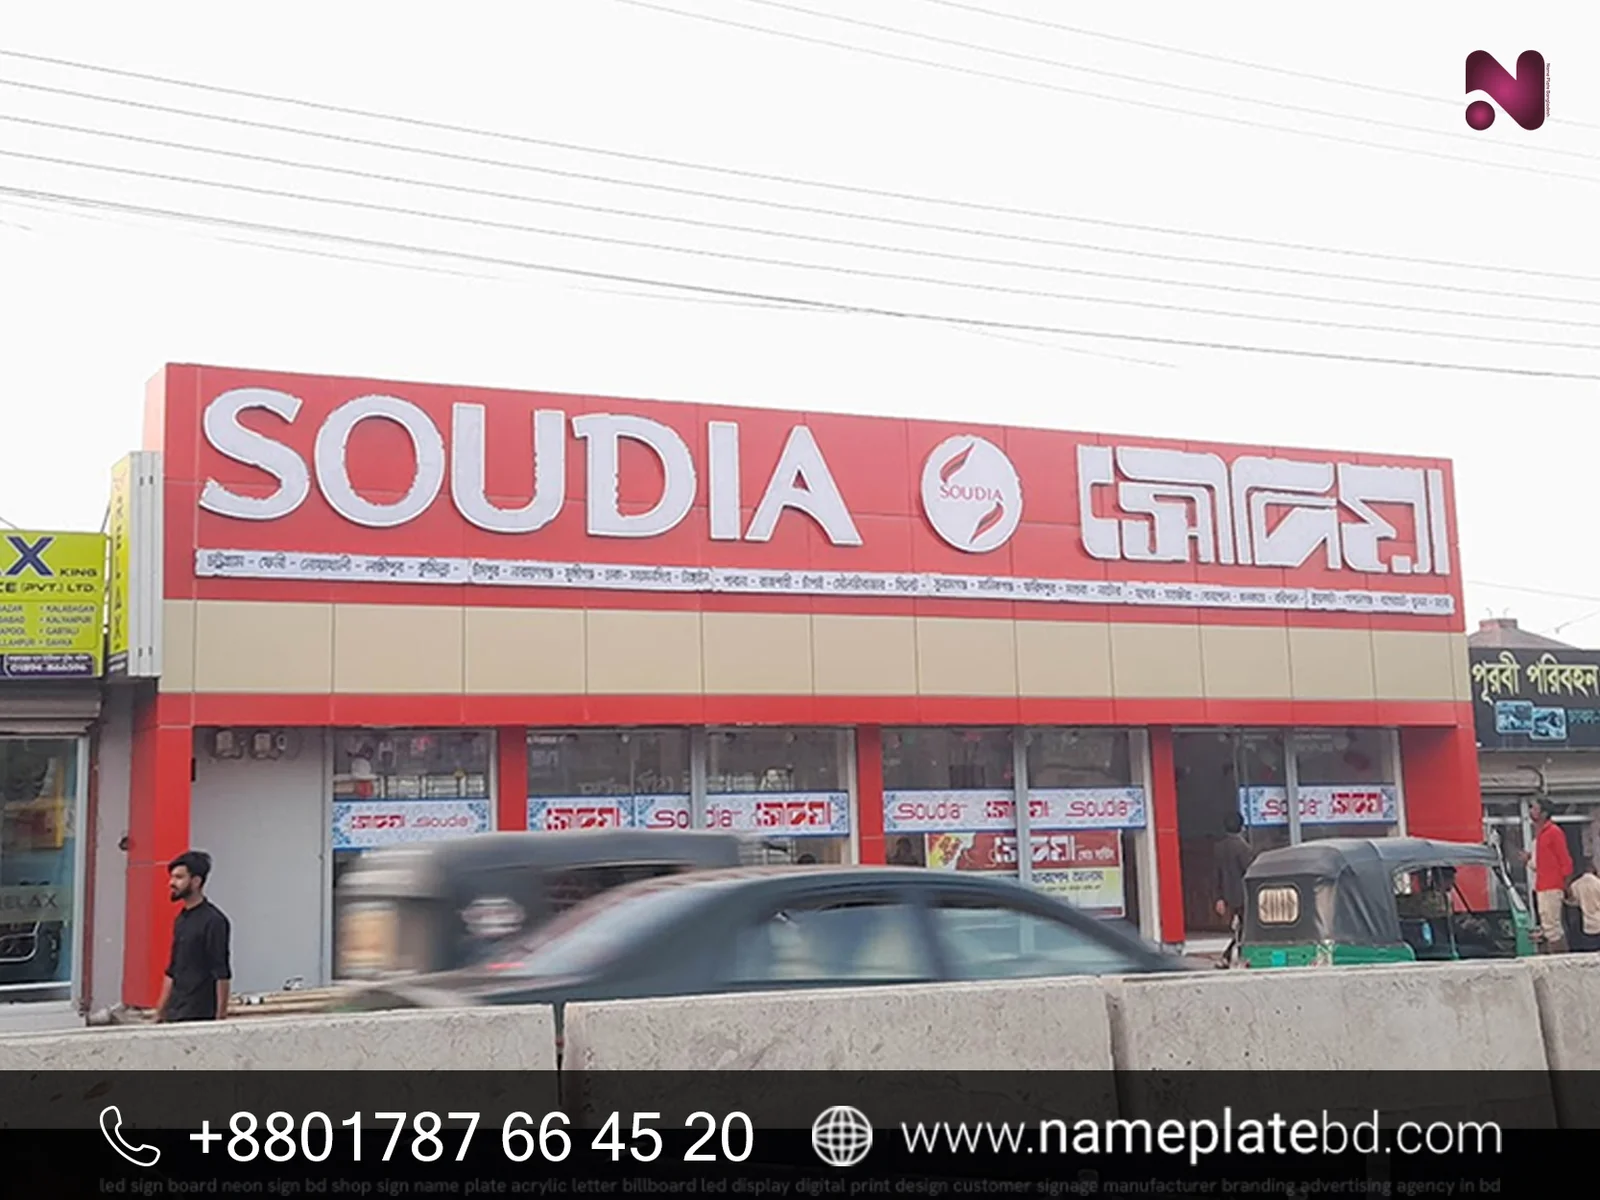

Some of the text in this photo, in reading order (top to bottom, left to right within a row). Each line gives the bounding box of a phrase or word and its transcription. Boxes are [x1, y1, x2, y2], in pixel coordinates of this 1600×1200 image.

[199, 387, 863, 547] SOUDIA
[939, 484, 1004, 502] SOUDIA
[0, 534, 98, 578] X KING
[0, 581, 17, 593] E
[1526, 652, 1600, 698] পরিবহন
